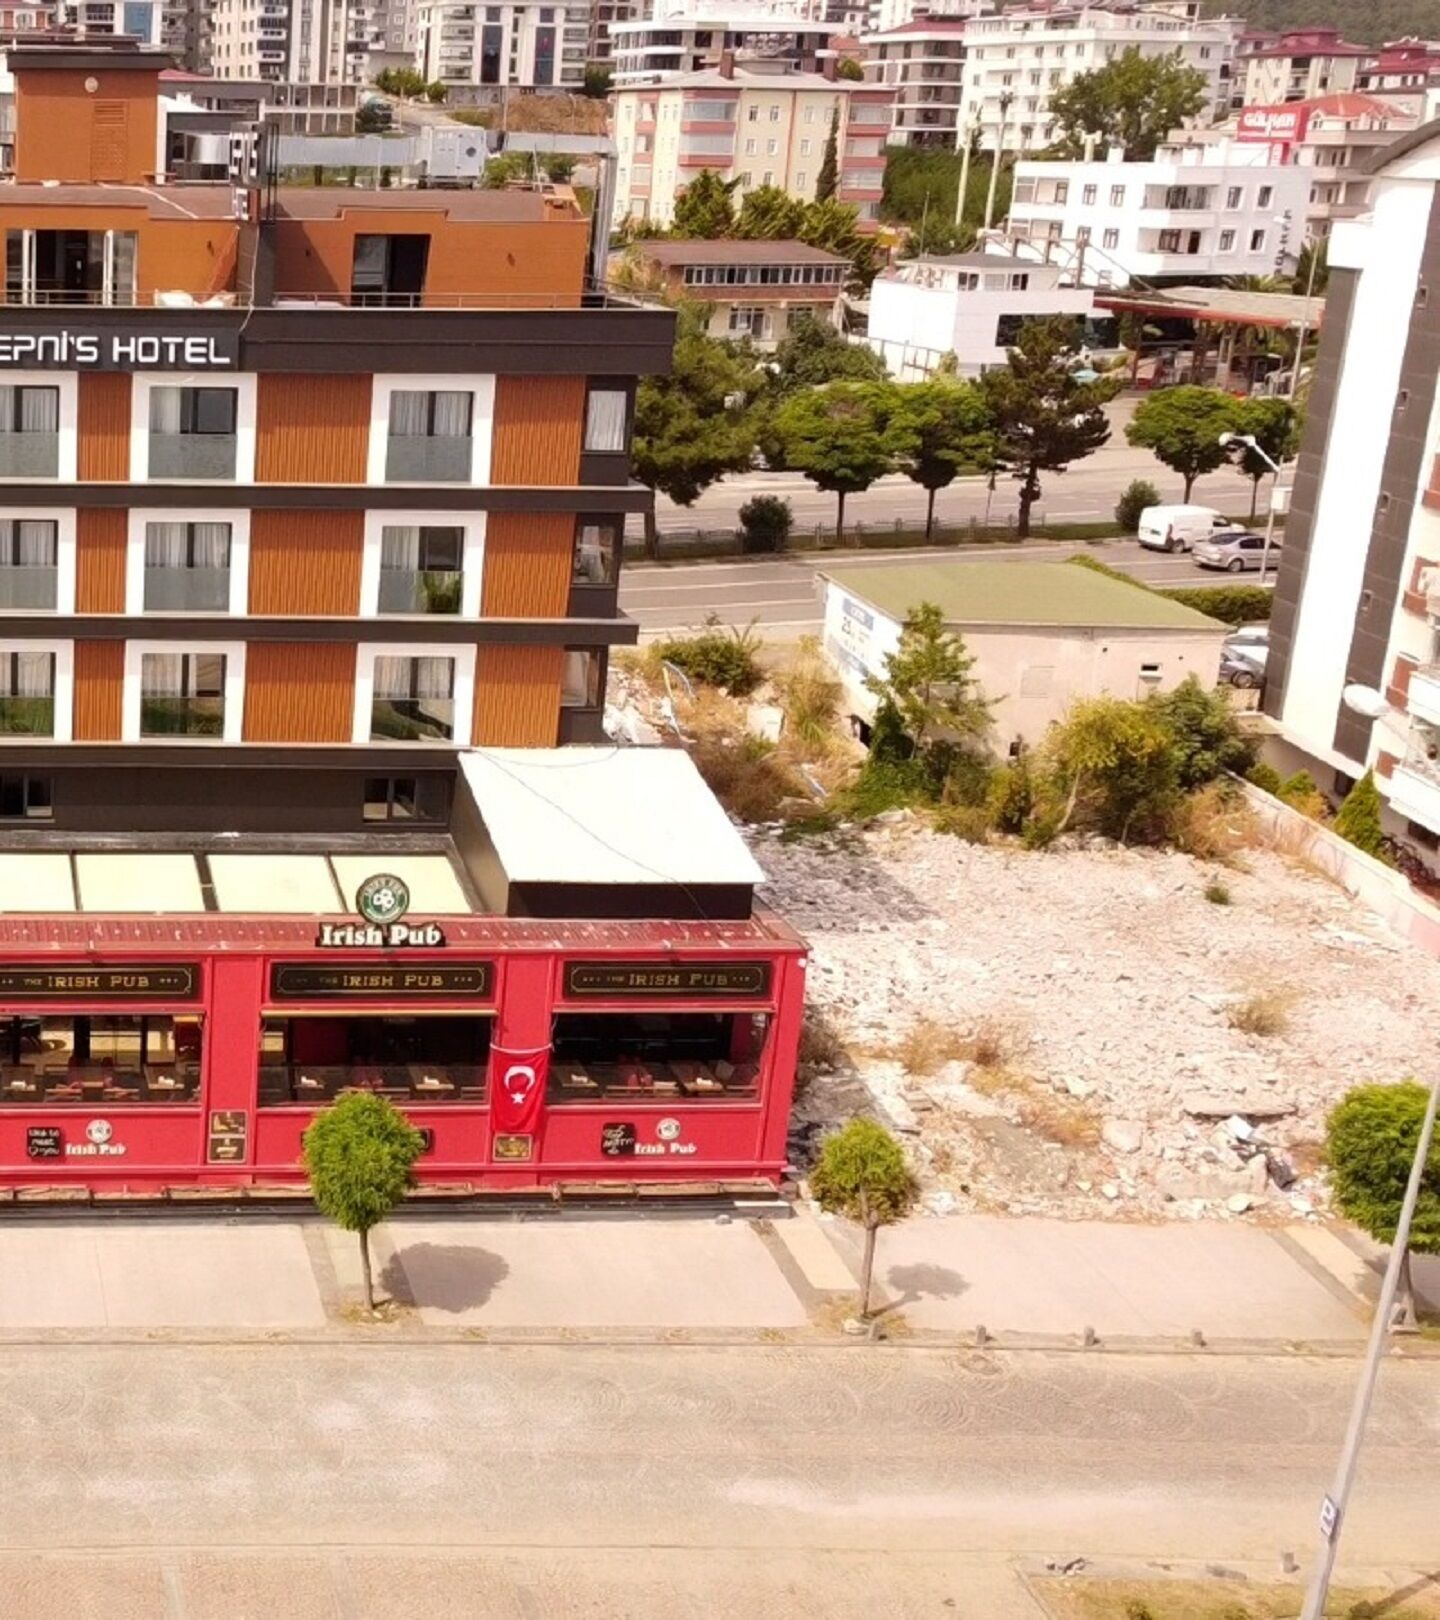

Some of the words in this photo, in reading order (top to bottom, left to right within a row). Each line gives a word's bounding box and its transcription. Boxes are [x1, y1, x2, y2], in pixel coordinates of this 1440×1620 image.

[112, 336, 231, 364] HOTEL
[320, 924, 383, 946] Irish
[390, 924, 442, 946] Pub
[23, 978, 42, 986] THE
[48, 976, 99, 988] IRISH
[110, 976, 150, 988] PUB
[343, 975, 394, 987] IRISH
[404, 975, 444, 987] PUB
[628, 973, 680, 986] IRISH
[689, 973, 728, 986] PUB
[65, 1143, 97, 1155] Irish
[100, 1143, 126, 1155] Pub
[635, 1143, 665, 1155] Irish
[670, 1142, 697, 1153] Pub
